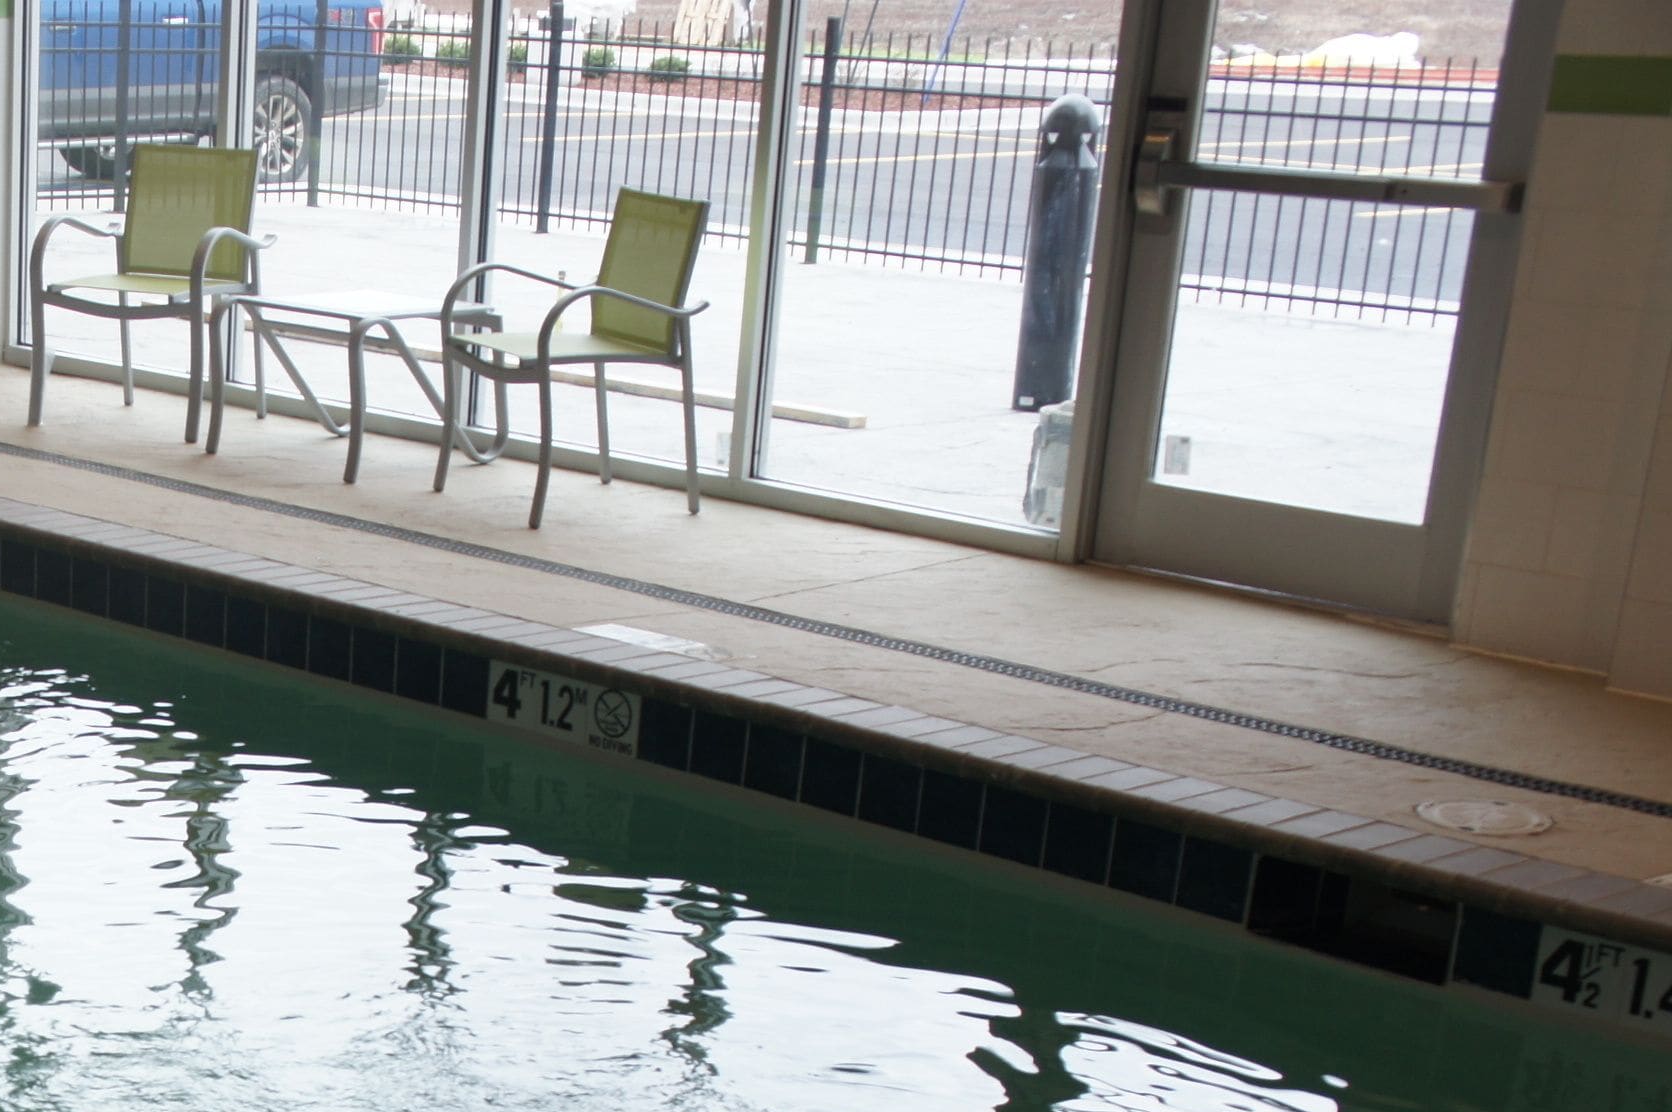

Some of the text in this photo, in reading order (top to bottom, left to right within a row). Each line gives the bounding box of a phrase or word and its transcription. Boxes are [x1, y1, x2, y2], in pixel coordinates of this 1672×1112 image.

[492, 668, 522, 719] 4
[520, 671, 537, 688] FT
[540, 679, 574, 731] 1.2
[1597, 943, 1626, 968] FT
